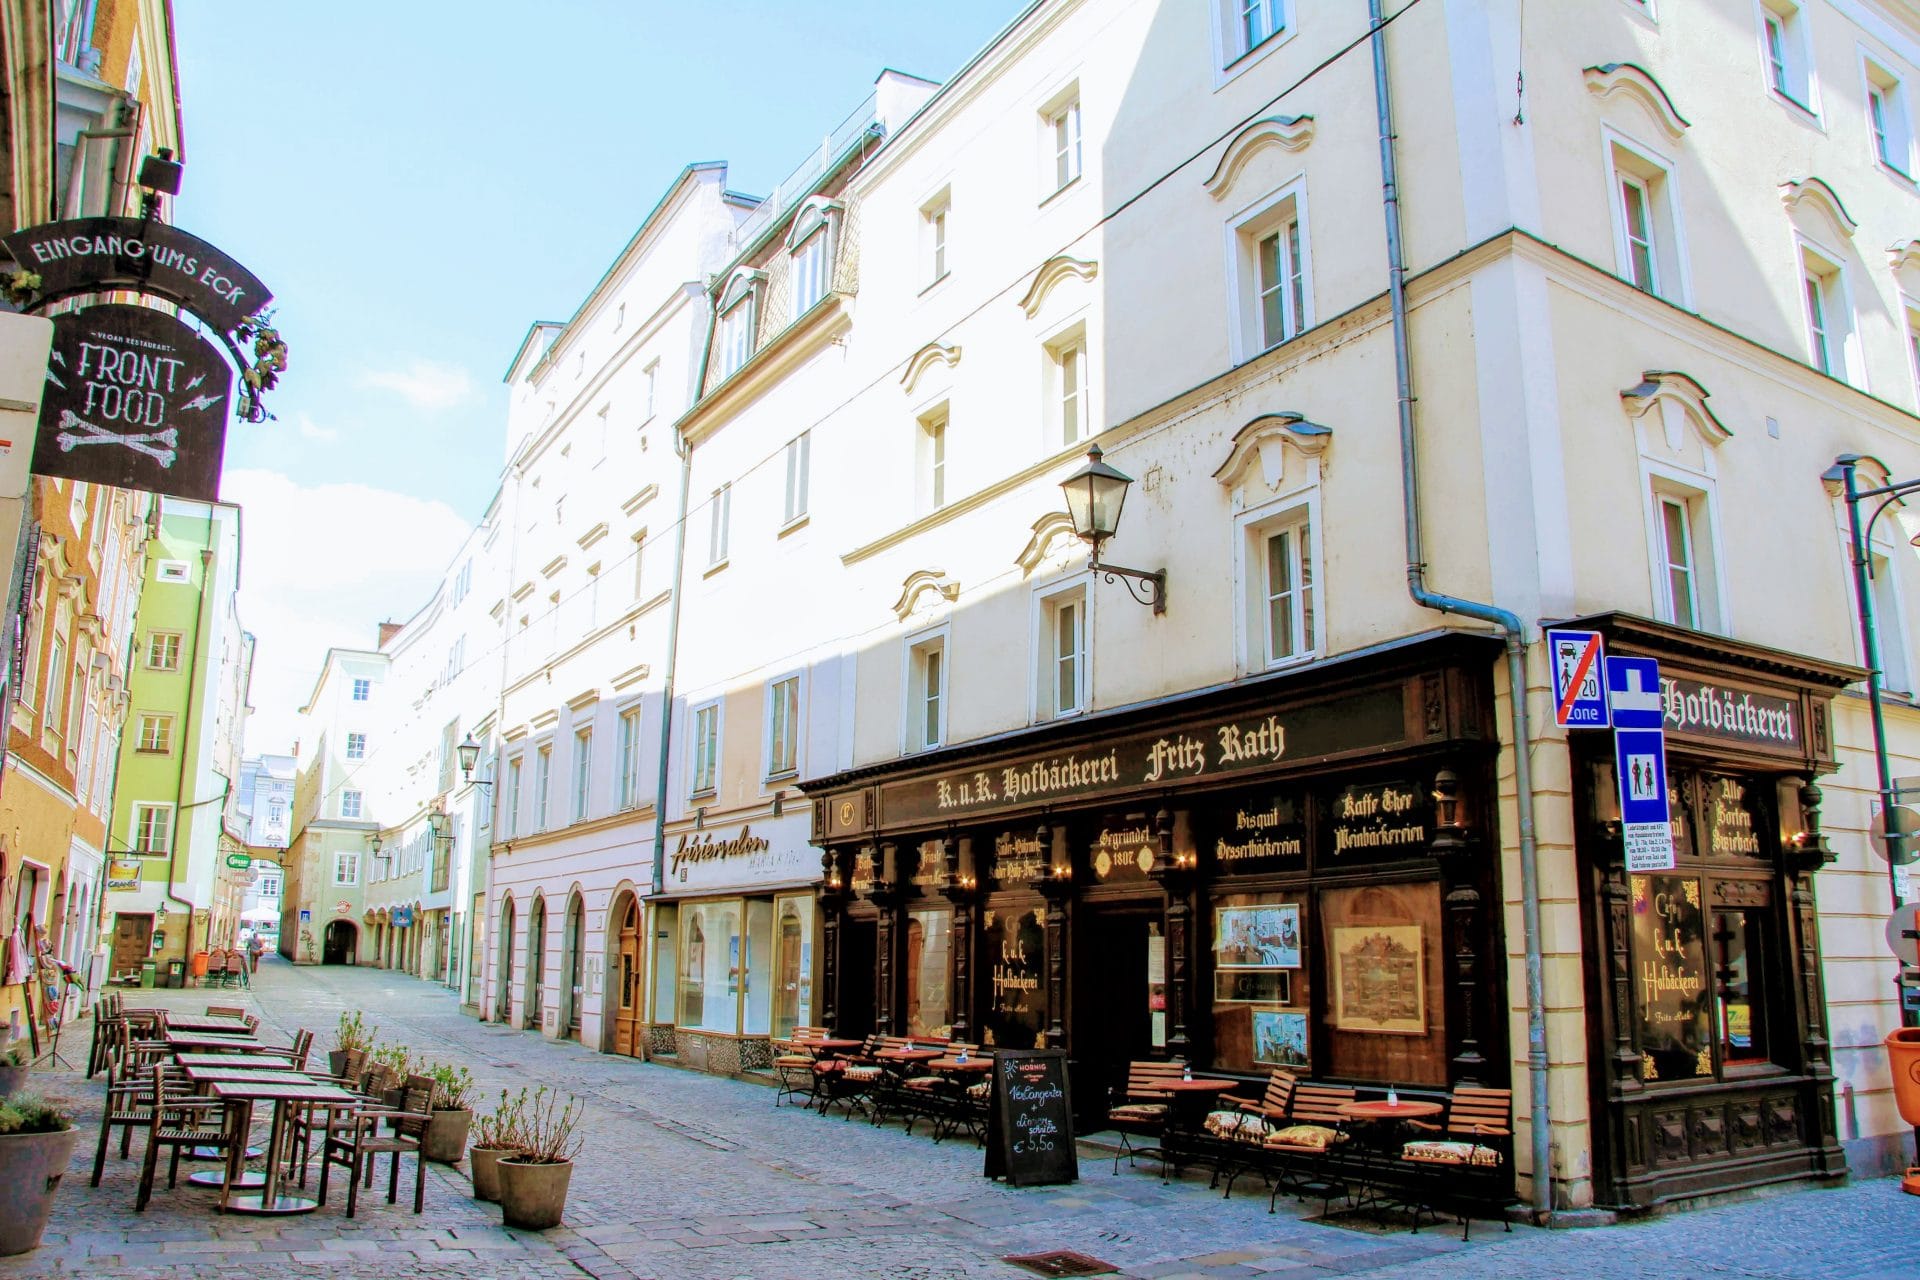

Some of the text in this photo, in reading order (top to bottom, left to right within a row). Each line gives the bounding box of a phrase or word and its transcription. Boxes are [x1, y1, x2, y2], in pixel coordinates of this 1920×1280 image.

[31, 236, 145, 263] EINGANG
[200, 267, 245, 305] ECK
[97, 332, 170, 351] VEGAN RESTAURANT
[77, 342, 185, 392] FRONT
[83, 380, 165, 427] FOOD
[1581, 679, 1597, 698] 20
[1661, 677, 1795, 741] Hofbäckerei
[1566, 704, 1599, 721] Zone
[1002, 748, 1119, 803] Hofbäckerei
[1144, 735, 1205, 782] Fritz
[1217, 716, 1286, 765] Rath
[1100, 825, 1149, 850] Gegründet
[1236, 807, 1279, 831] Bisquit
[991, 964, 1038, 1011] Hofbäckerei
[1642, 960, 1699, 1021] Hofbäckerei
[1019, 1063, 1047, 1071] HORNIG
